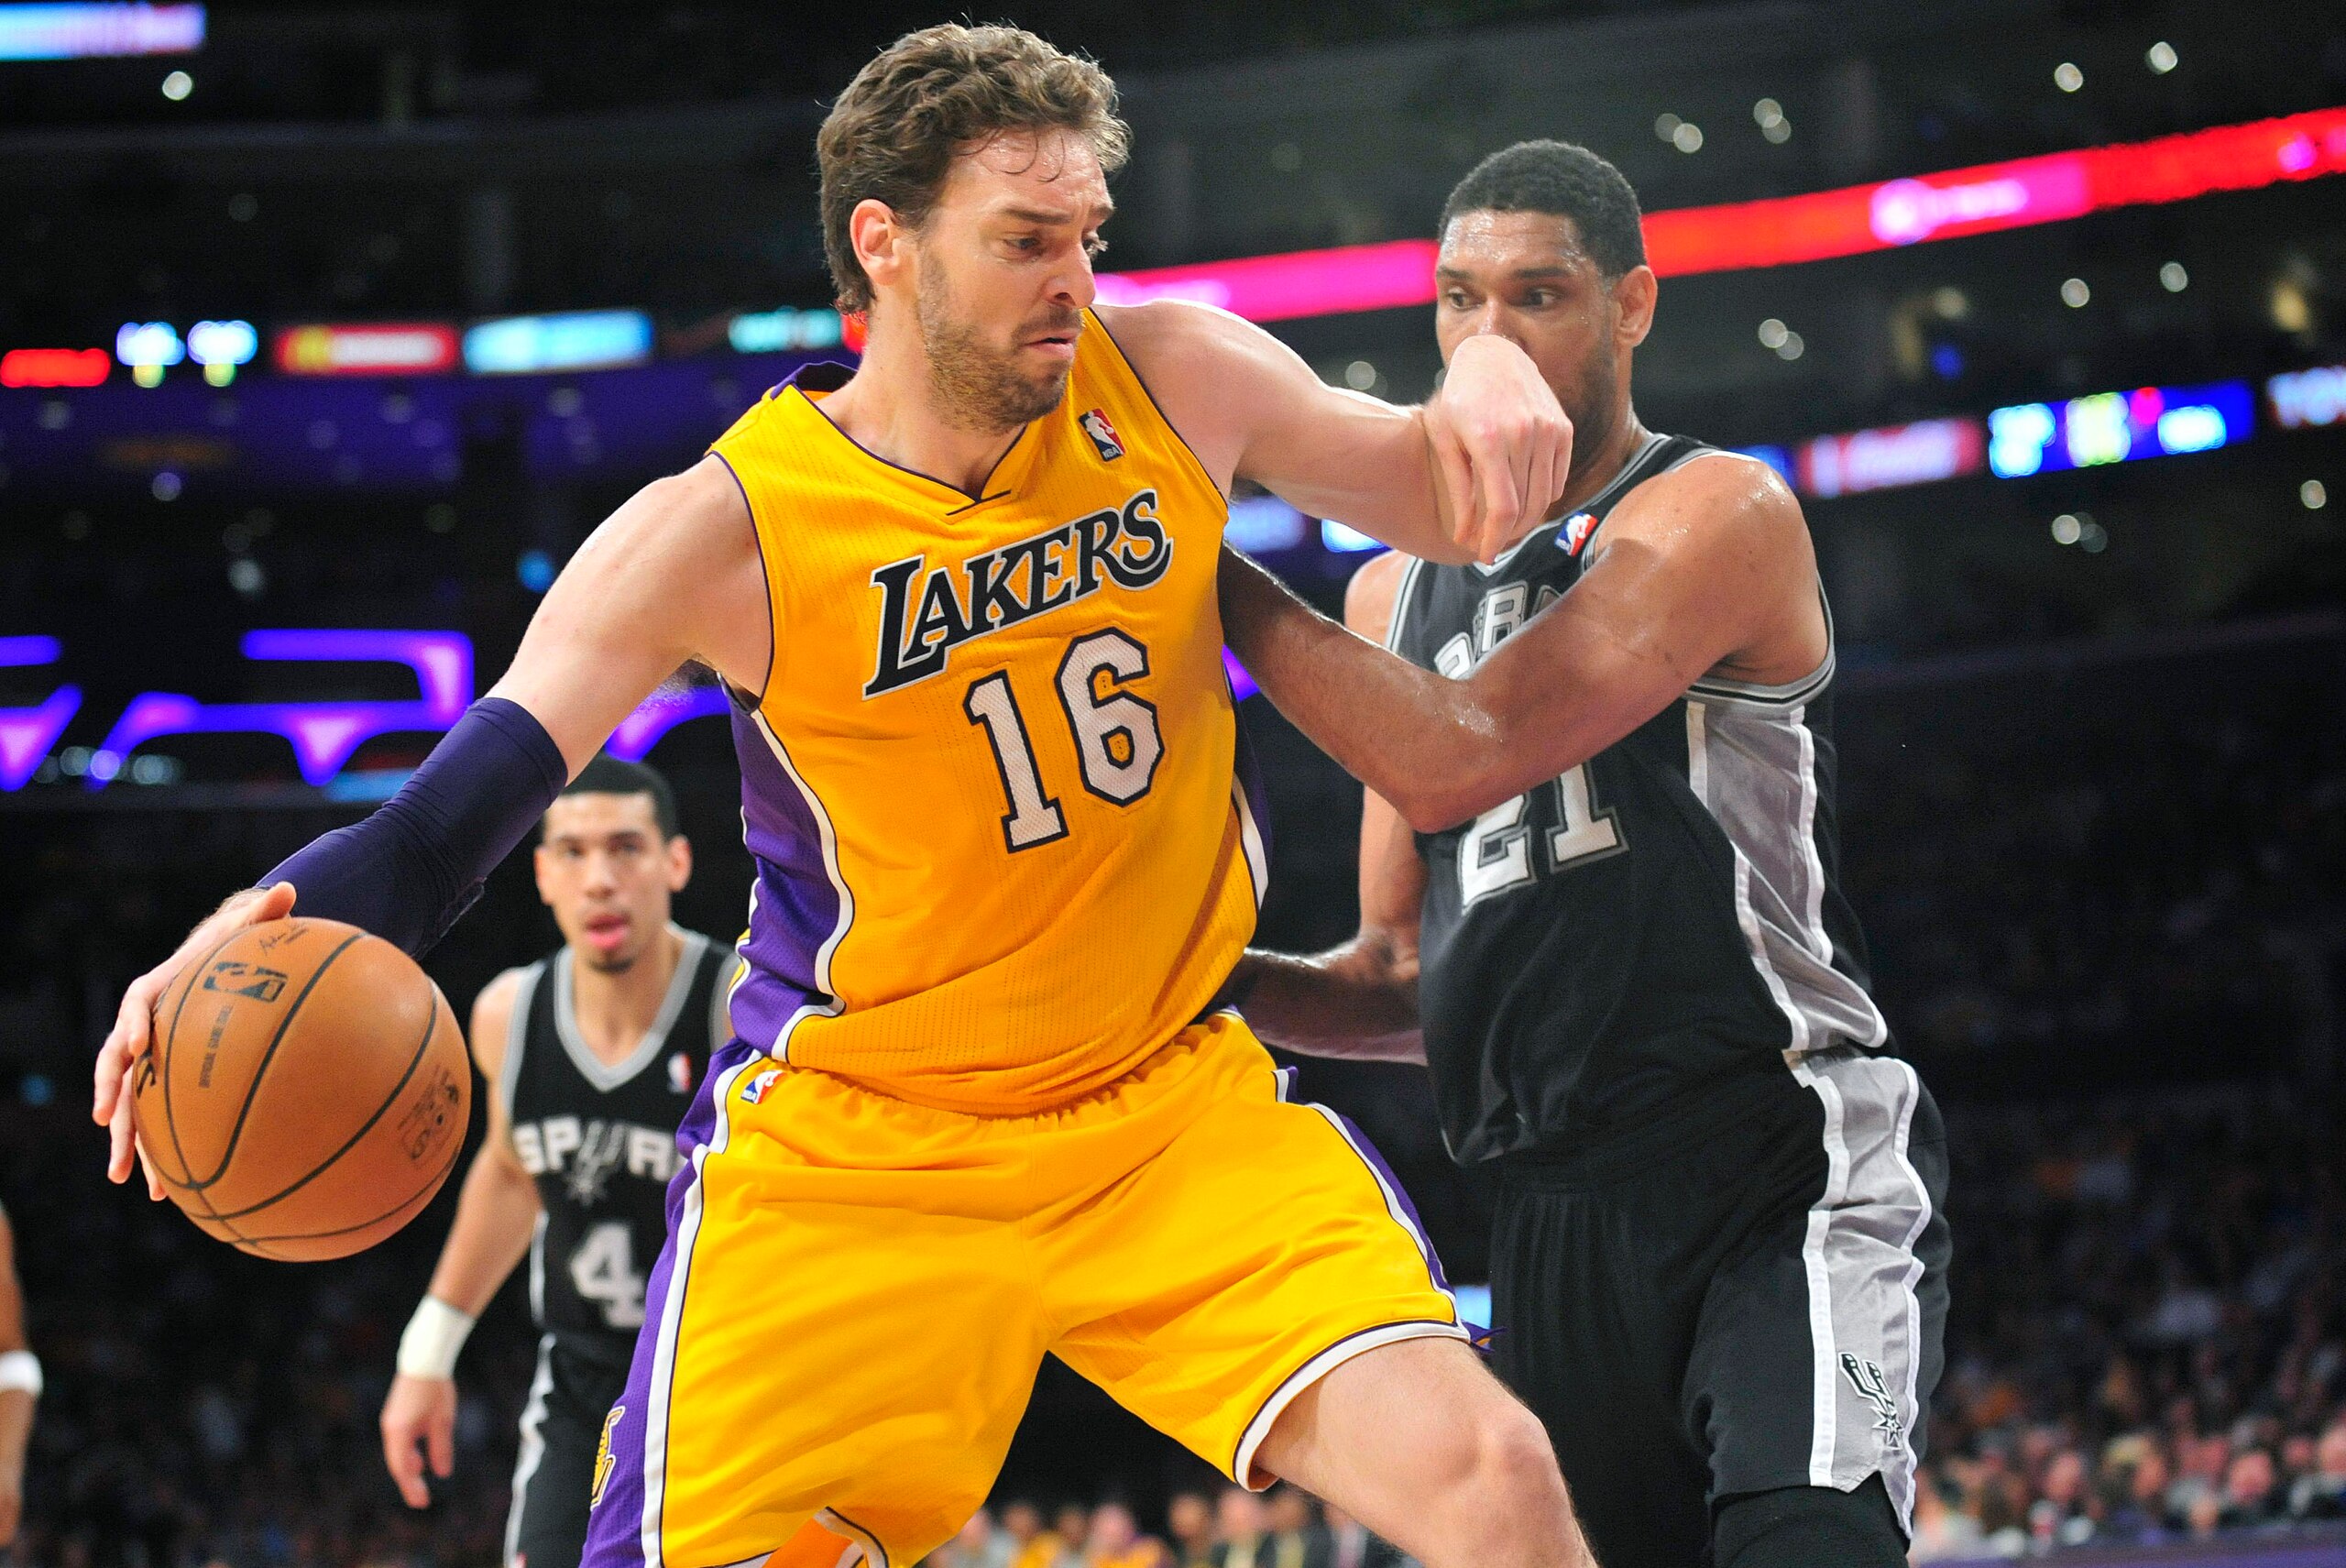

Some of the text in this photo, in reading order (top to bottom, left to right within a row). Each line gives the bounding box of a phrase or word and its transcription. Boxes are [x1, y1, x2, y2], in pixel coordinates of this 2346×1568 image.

[861, 488, 1174, 701] LAKERS
[962, 627, 1165, 854] 16
[570, 1222, 647, 1329] 4
